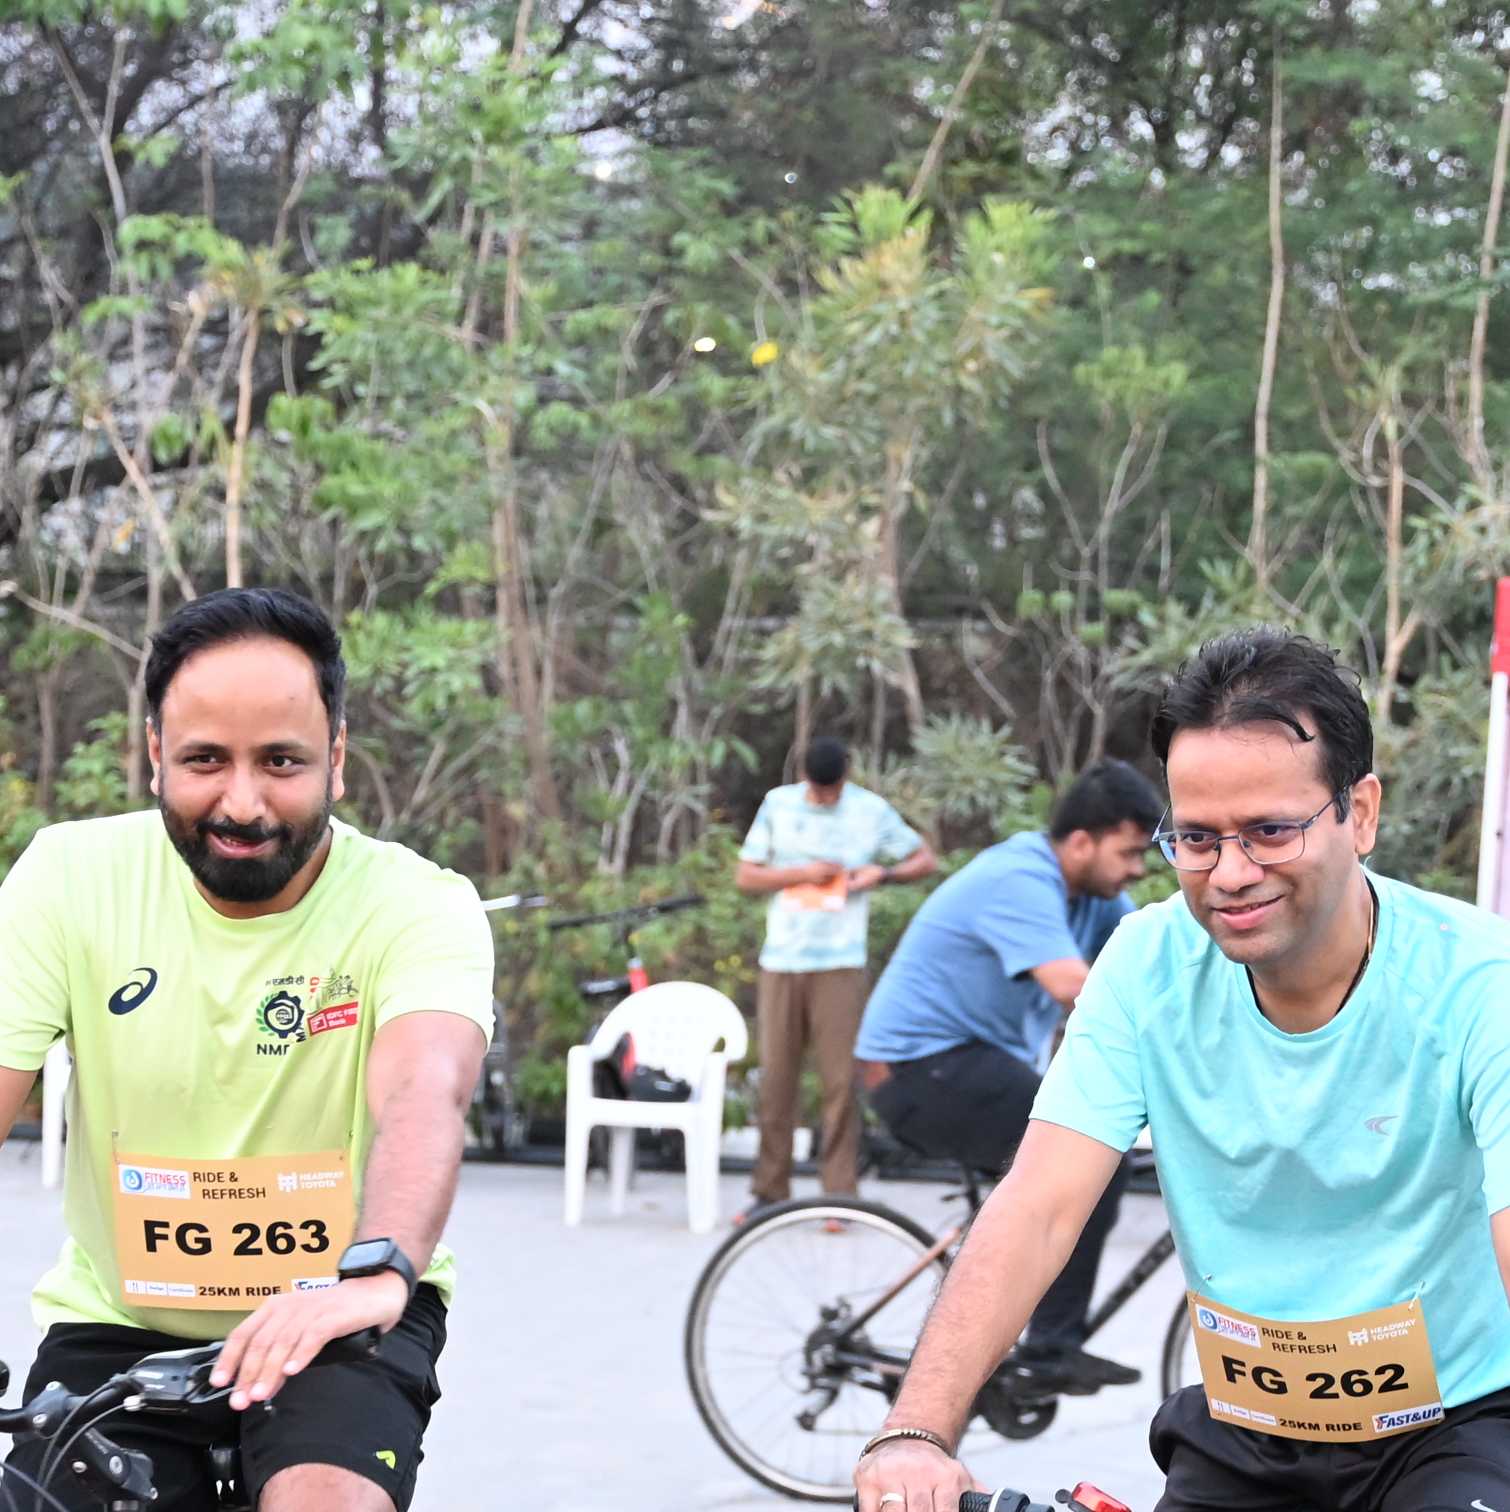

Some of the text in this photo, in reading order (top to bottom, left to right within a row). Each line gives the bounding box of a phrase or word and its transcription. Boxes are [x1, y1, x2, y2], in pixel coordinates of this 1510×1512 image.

[144, 1171, 344, 1186] FITNESS RIDE & HEADWAY
[300, 1180, 337, 1189] TOYOTA
[202, 1187, 266, 1200] REFRESH
[144, 1219, 330, 1256] FG 263
[199, 1286, 241, 1297] 25KM
[245, 1286, 282, 1297] RIDE
[1218, 1316, 1257, 1337] FITNESS
[1261, 1327, 1294, 1341] RIDE
[1297, 1331, 1307, 1341] &
[1370, 1318, 1416, 1335] HEADWAY
[1372, 1328, 1409, 1341] TOYOTA
[1272, 1342, 1337, 1355] REFRESH
[1221, 1354, 1410, 1400] FG 262
[1279, 1418, 1321, 1432] 25KM
[1325, 1421, 1363, 1432] RIDE
[1376, 1407, 1441, 1428] FAST&UP
